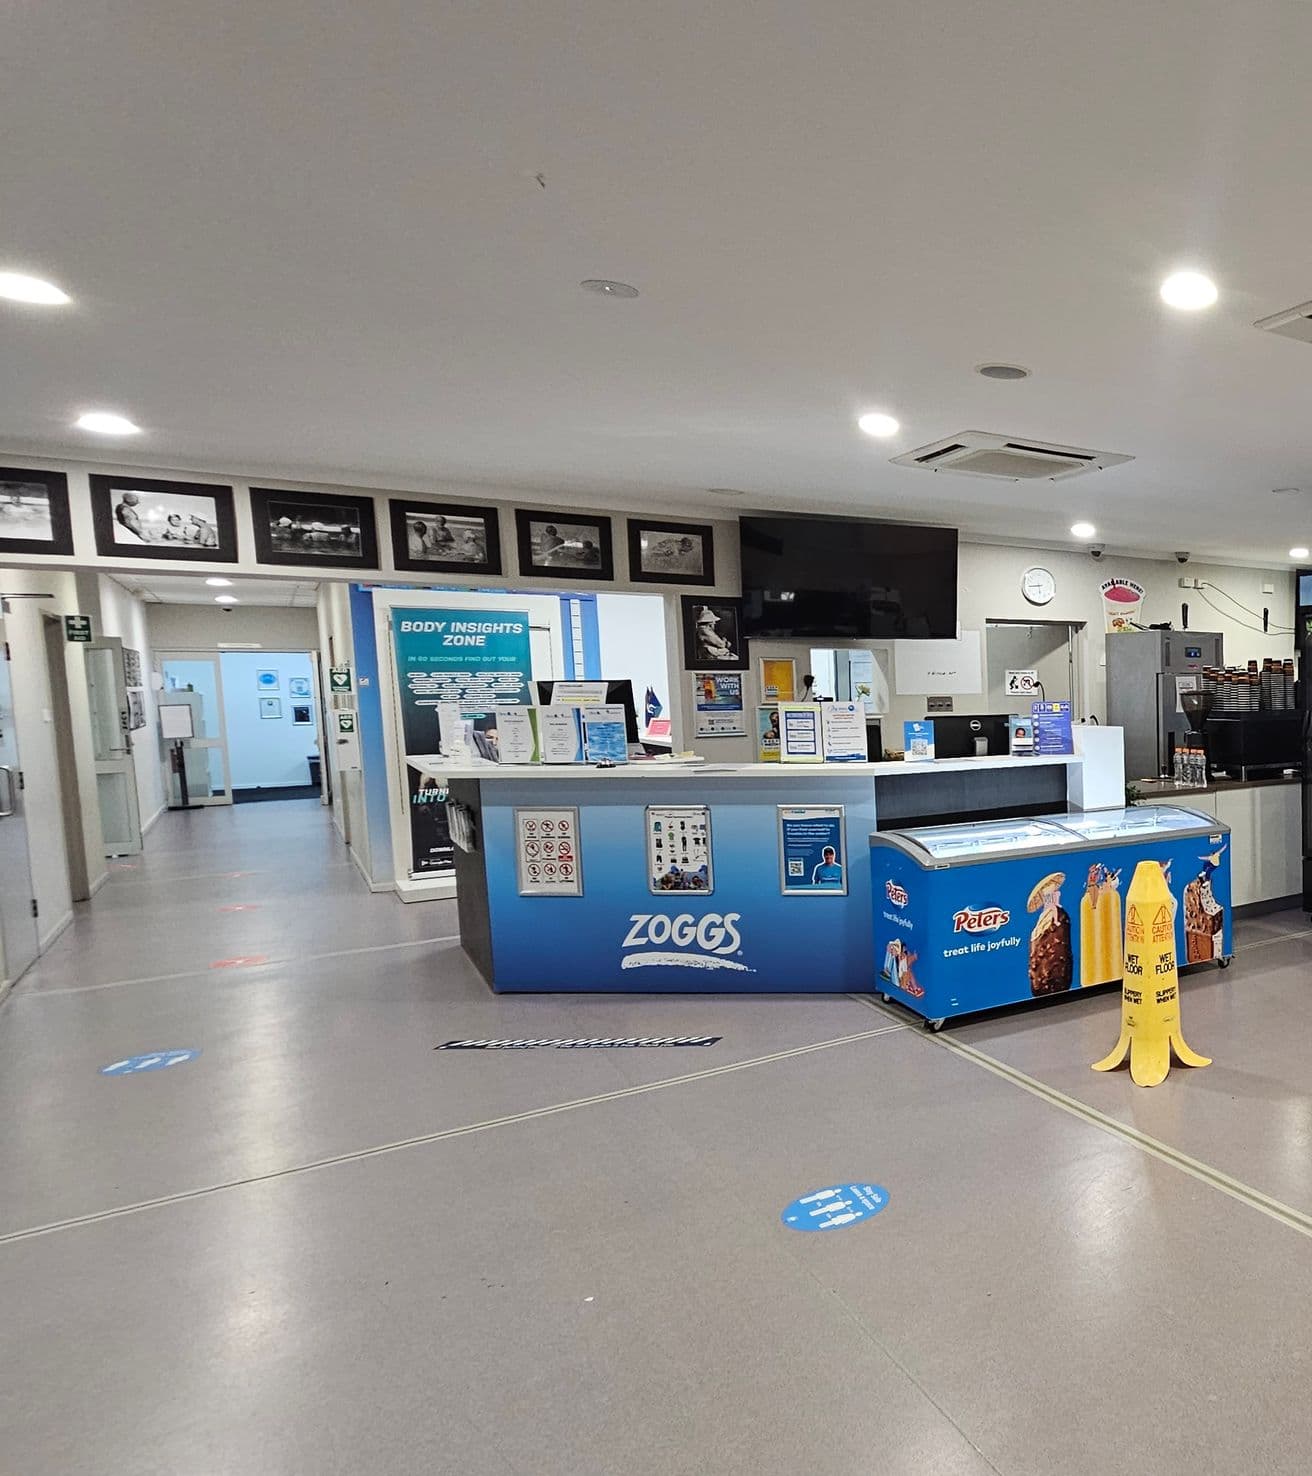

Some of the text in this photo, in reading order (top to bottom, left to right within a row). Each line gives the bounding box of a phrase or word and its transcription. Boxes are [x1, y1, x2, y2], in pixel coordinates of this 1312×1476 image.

[1101, 579, 1128, 590] AVAABLE
[400, 621, 523, 634] BODY INSIGHTS
[442, 635, 486, 646] ZONE
[413, 794, 446, 804] INTO
[886, 882, 908, 905] Peters
[954, 910, 1010, 932] Peters
[622, 912, 741, 955] ZOGGS
[943, 936, 1021, 958] treat life joyfully
[1159, 952, 1172, 963] WET
